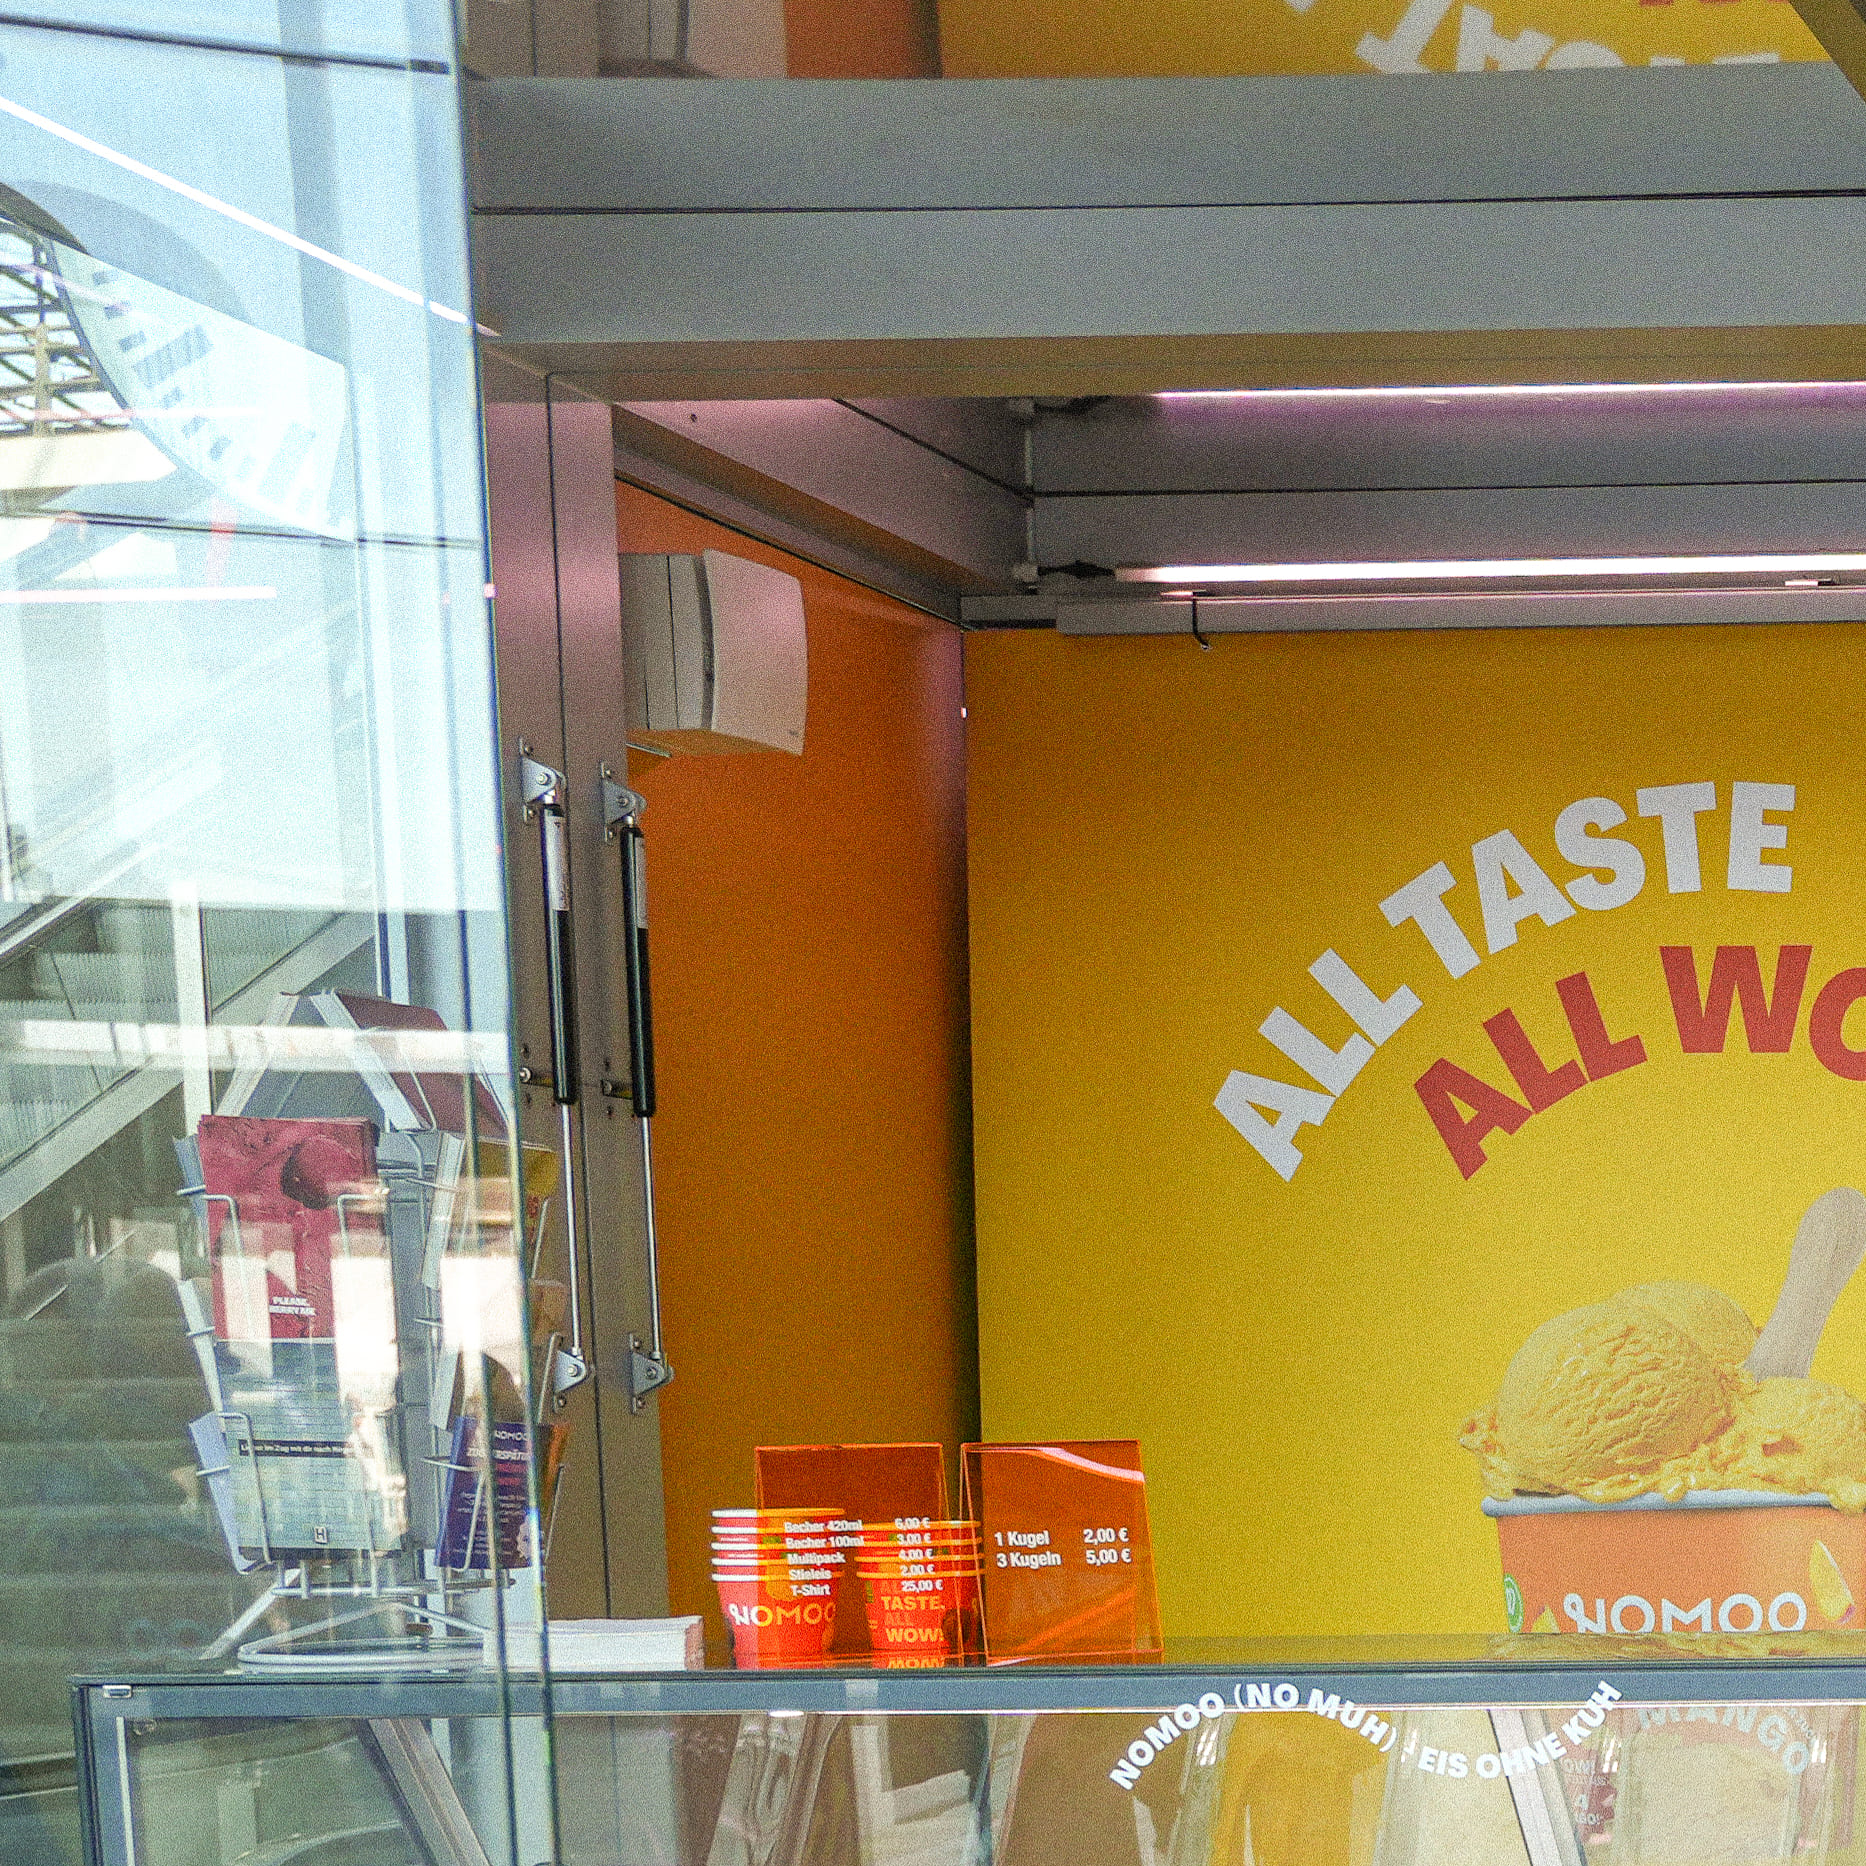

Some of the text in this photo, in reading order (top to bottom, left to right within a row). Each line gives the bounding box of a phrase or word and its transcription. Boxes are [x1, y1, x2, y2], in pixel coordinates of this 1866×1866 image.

[1212, 781, 1795, 1182] ALL TASTE
[1412, 971, 1648, 1180] ALL
[784, 1521, 824, 1534] Becher
[994, 1527, 1129, 1549] 1 Kugel 2,00 €
[786, 1537, 826, 1549] Becher
[829, 1535, 865, 1548] 100ml
[787, 1552, 845, 1566] Multipack
[996, 1548, 1132, 1570] 3 Kugeln 5,00 €
[789, 1568, 831, 1580] Stieleis
[790, 1583, 831, 1596] T-Shirt
[901, 1580, 933, 1593] 25,00
[1563, 1592, 1808, 1632] NOMOO
[1109, 1680, 1622, 1791] NOMOO (NO MUH) EIS OHNE KUH
